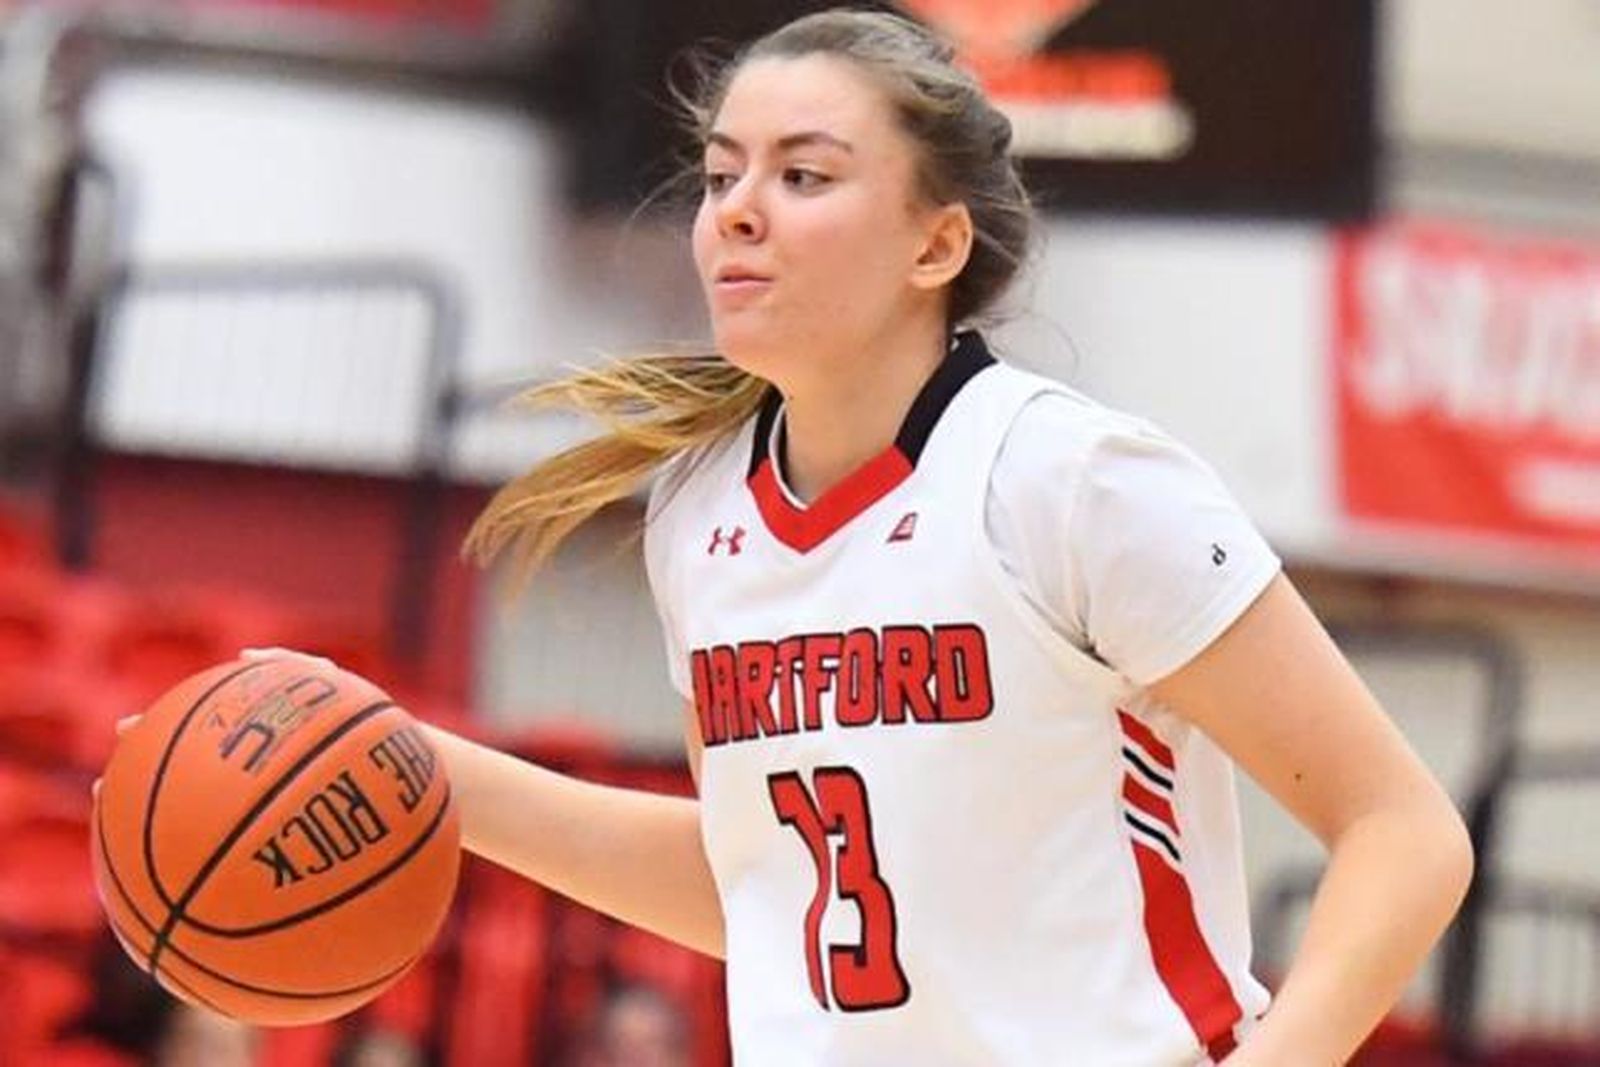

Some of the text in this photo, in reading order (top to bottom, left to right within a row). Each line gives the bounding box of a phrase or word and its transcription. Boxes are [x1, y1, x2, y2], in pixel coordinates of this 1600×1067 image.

[252, 725, 436, 888] THE ROCK
[766, 766, 911, 1013] 13
